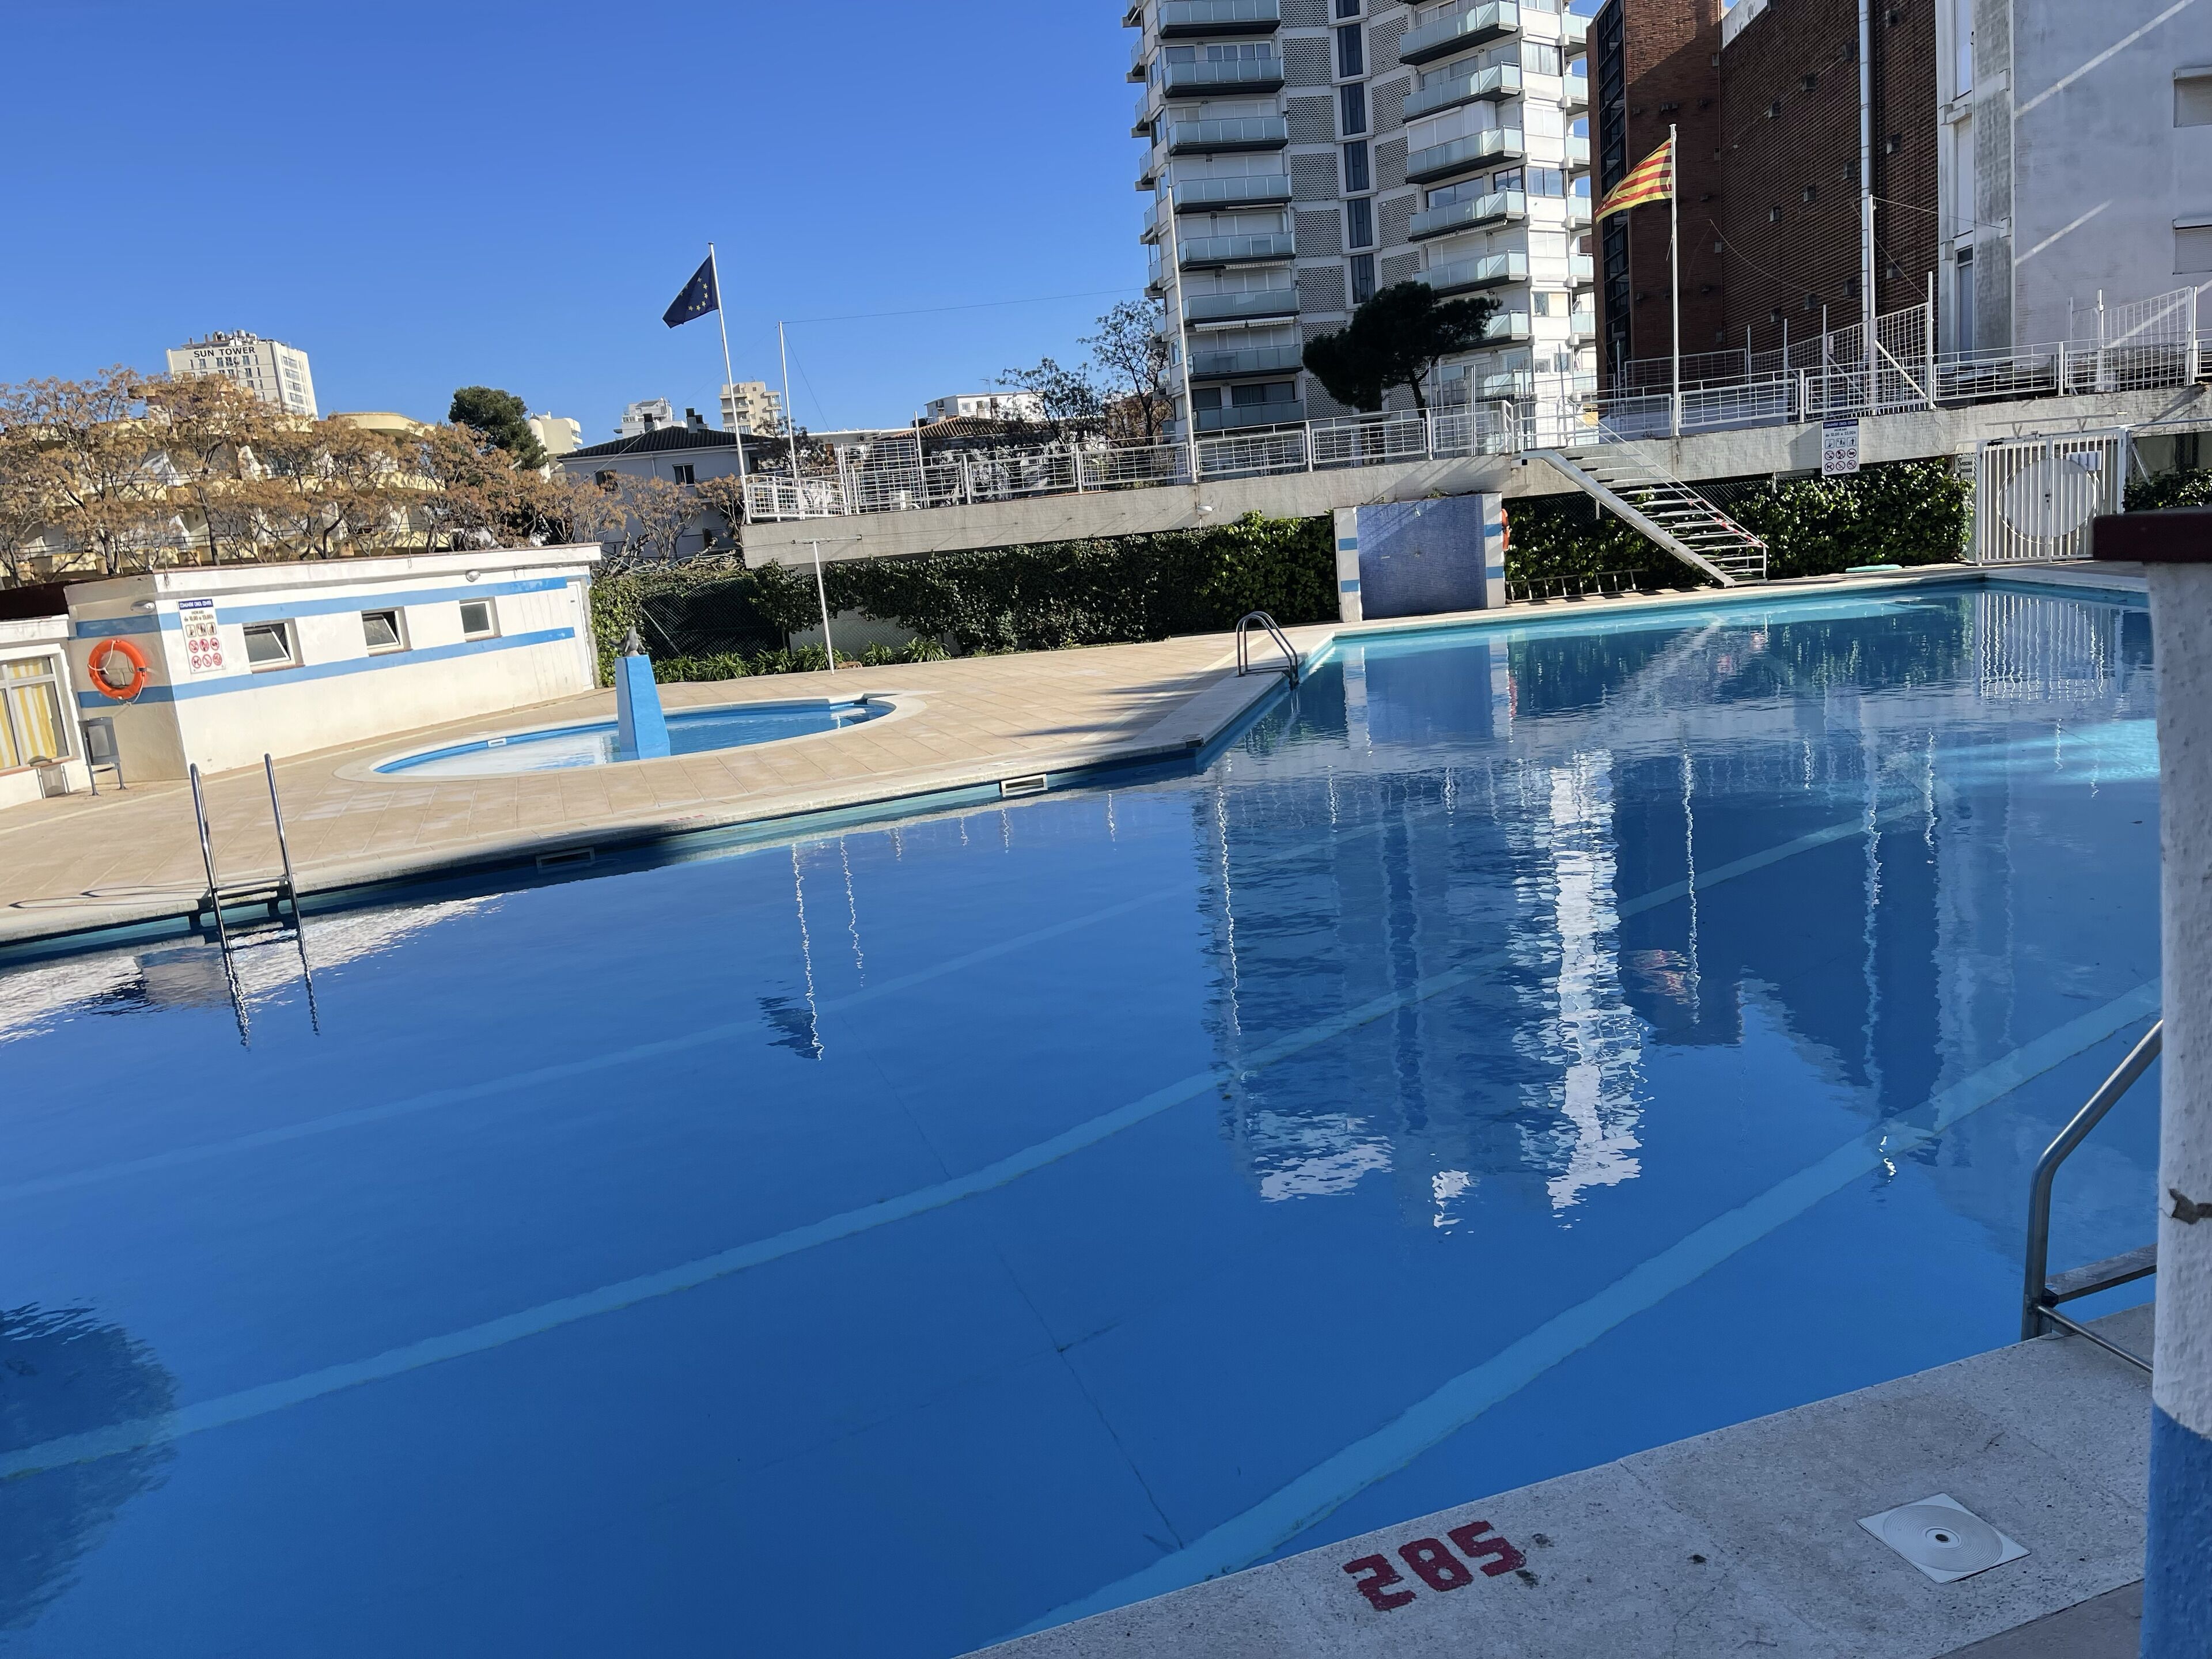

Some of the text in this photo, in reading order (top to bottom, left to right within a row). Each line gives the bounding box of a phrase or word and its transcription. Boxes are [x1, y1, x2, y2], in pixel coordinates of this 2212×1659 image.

[194, 347, 255, 358] SUN TOWER
[1342, 1520, 1527, 1612] 285
